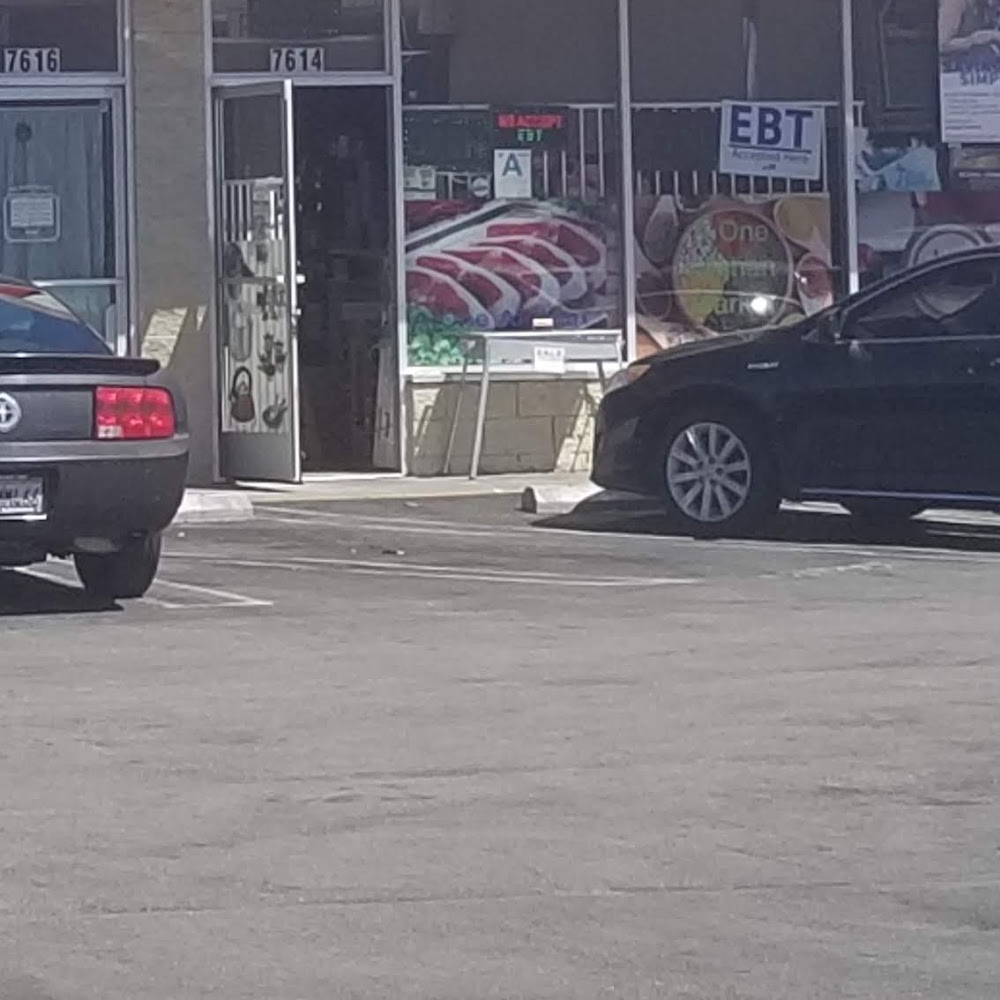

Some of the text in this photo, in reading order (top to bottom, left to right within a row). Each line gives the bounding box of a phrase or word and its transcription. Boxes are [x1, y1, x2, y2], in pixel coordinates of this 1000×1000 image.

[7, 50, 58, 72] 7616
[272, 49, 321, 72] 7614
[729, 104, 814, 149] EBT
[502, 152, 522, 177] A
[718, 219, 771, 242] One
